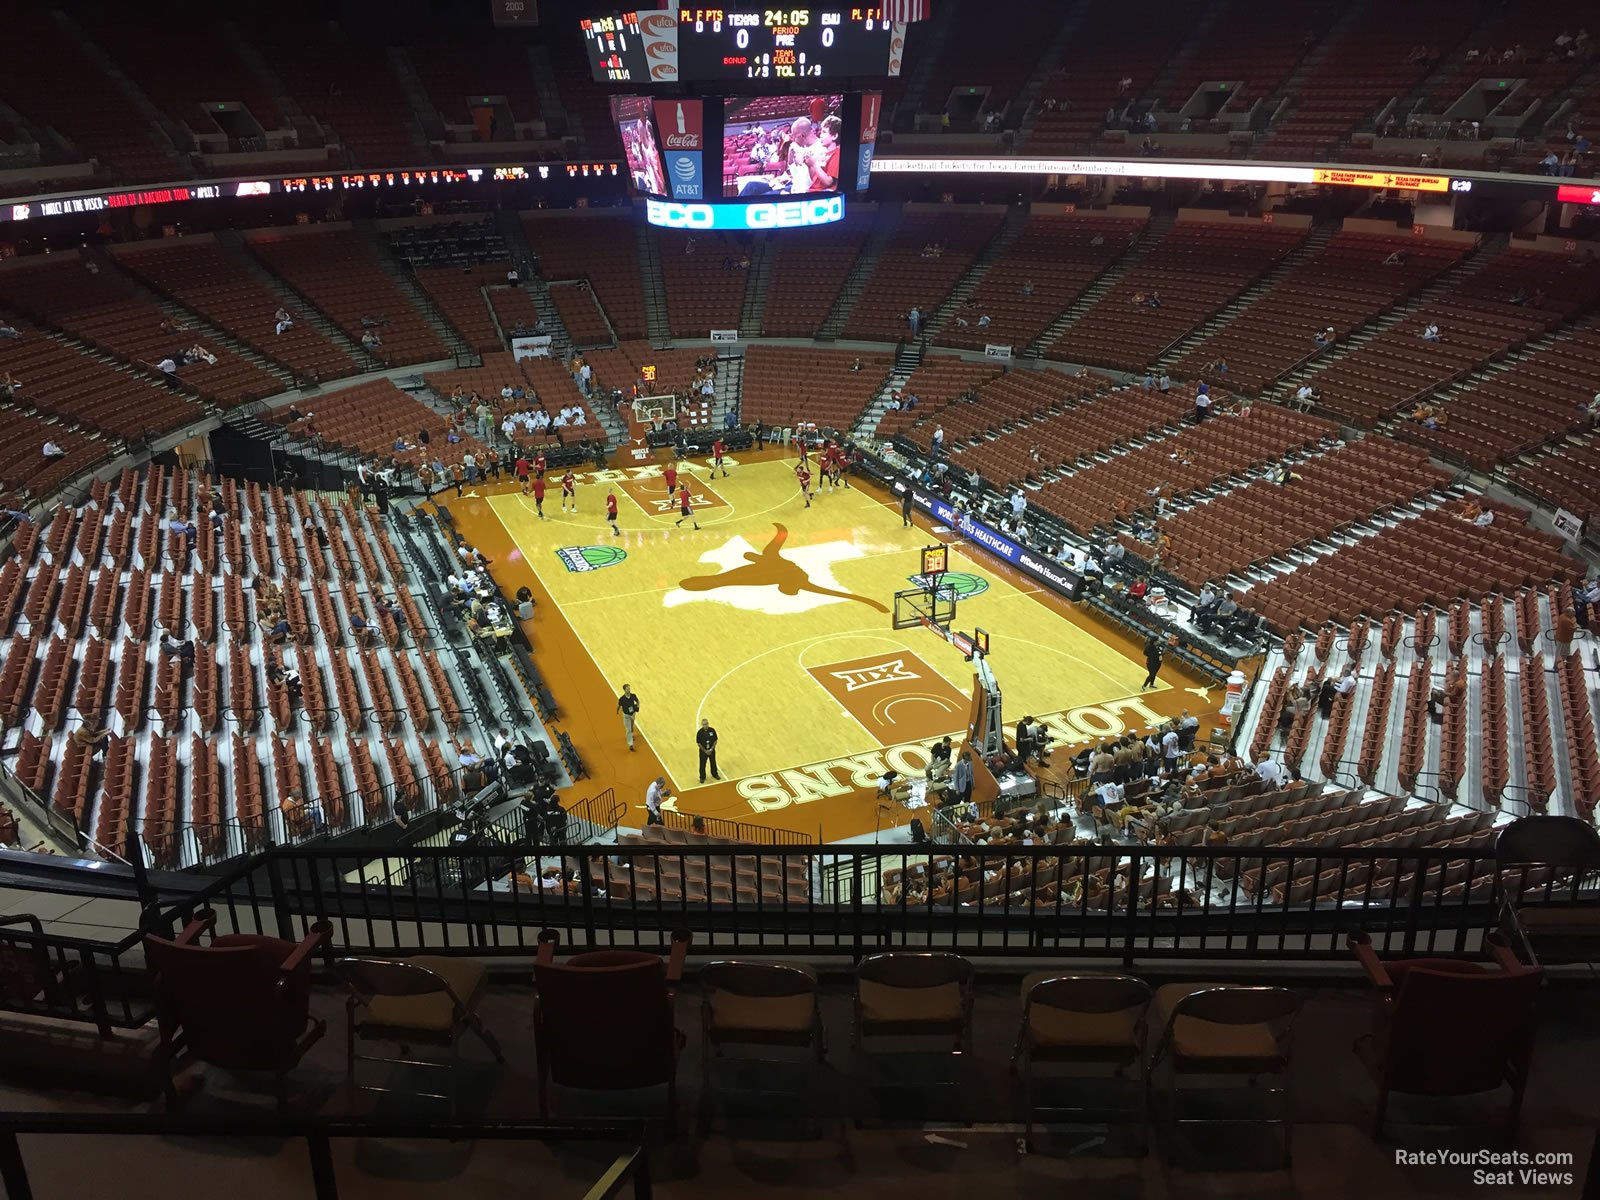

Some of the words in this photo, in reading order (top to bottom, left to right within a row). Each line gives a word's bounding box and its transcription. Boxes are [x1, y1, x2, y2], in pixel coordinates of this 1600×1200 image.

[681, 10, 693, 21] PL
[697, 10, 703, 21] F
[706, 10, 723, 22] PTS
[728, 14, 760, 26] TEXAS
[764, 10, 810, 26] 24:05
[851, 9, 862, 20] PL
[656, 16, 674, 27] ufcu
[736, 29, 749, 48] 0
[775, 35, 795, 46] PRE
[821, 28, 834, 47] 0
[776, 66, 795, 77] TOL
[197, 186, 214, 199] APRIL
[215, 185, 220, 197] 2
[675, 185, 699, 195] AT&T
[746, 197, 842, 229] GEICO
[1263, 214, 1273, 223] 22
[1414, 226, 1424, 235] 21
[1564, 241, 1576, 250] 20
[644, 372, 655, 380] 30
[974, 526, 1014, 557] HEALTHCARE
[927, 557, 943, 573] 30
[735, 697, 1172, 814] LONORNS
